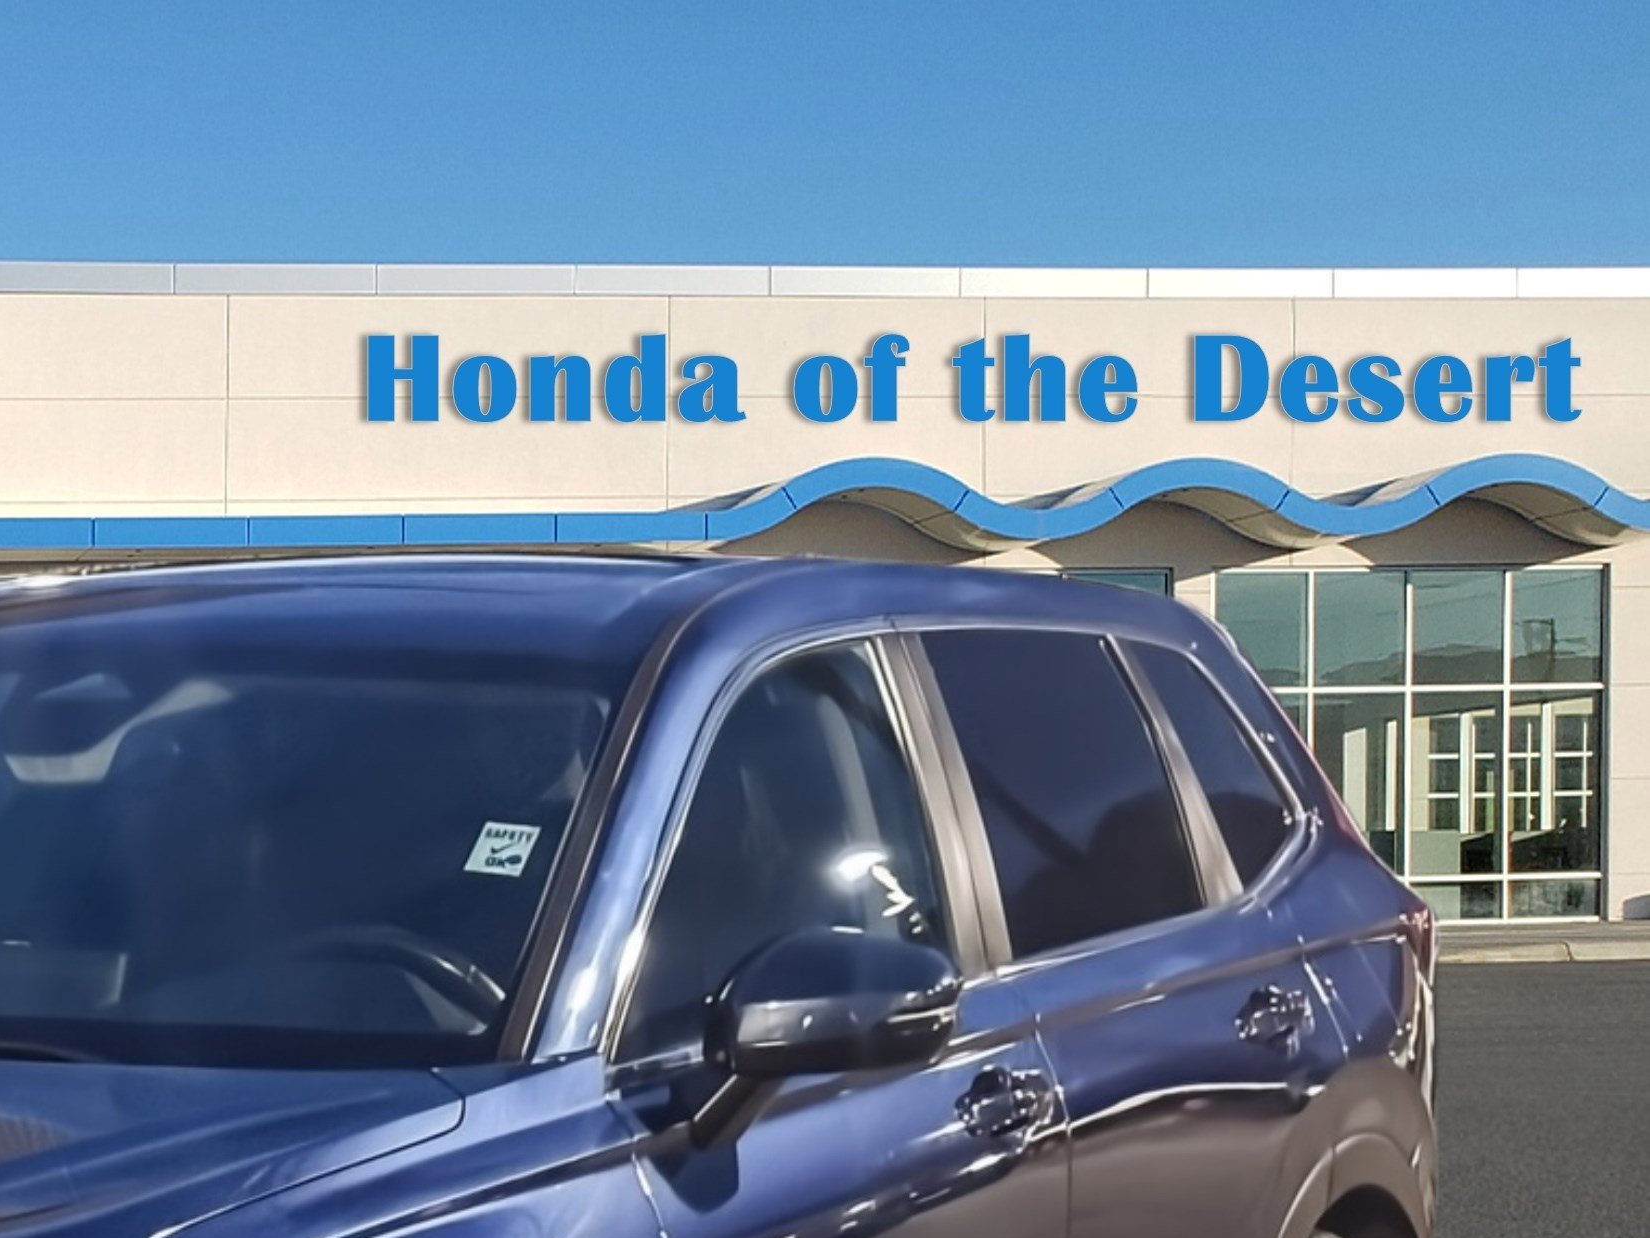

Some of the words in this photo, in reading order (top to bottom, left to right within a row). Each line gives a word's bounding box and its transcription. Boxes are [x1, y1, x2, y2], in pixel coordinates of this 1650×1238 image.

[366, 333, 747, 423] Honda
[793, 333, 911, 423] of
[951, 333, 1138, 423] the
[1193, 335, 1583, 423] Desert
